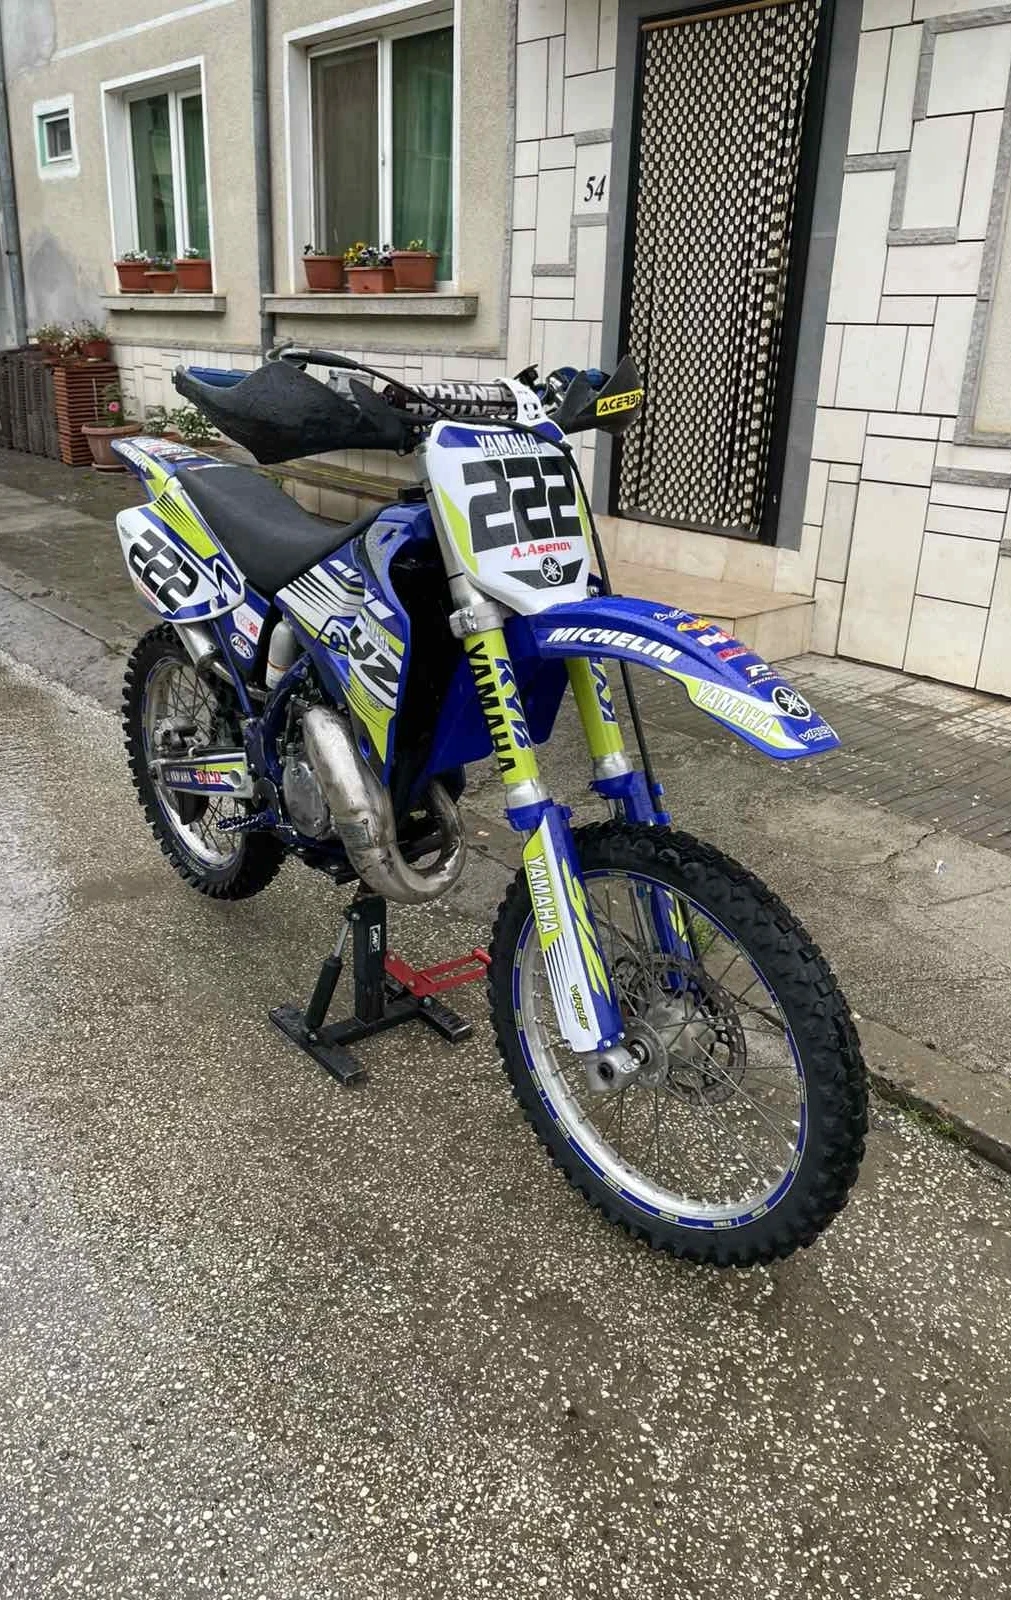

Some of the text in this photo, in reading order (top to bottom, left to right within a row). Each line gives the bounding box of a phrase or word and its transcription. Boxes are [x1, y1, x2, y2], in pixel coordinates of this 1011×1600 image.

[584, 175, 607, 202] 54
[474, 433, 542, 457] YAMAHA
[462, 456, 583, 554] 222
[128, 528, 200, 615] 222
[349, 624, 399, 699] YZ
[546, 627, 682, 663] MICHELIN
[466, 641, 517, 774] YAMAHA
[494, 658, 531, 749] KYB
[694, 681, 776, 738] YAMAHA
[526, 853, 562, 934] YAMAHA
